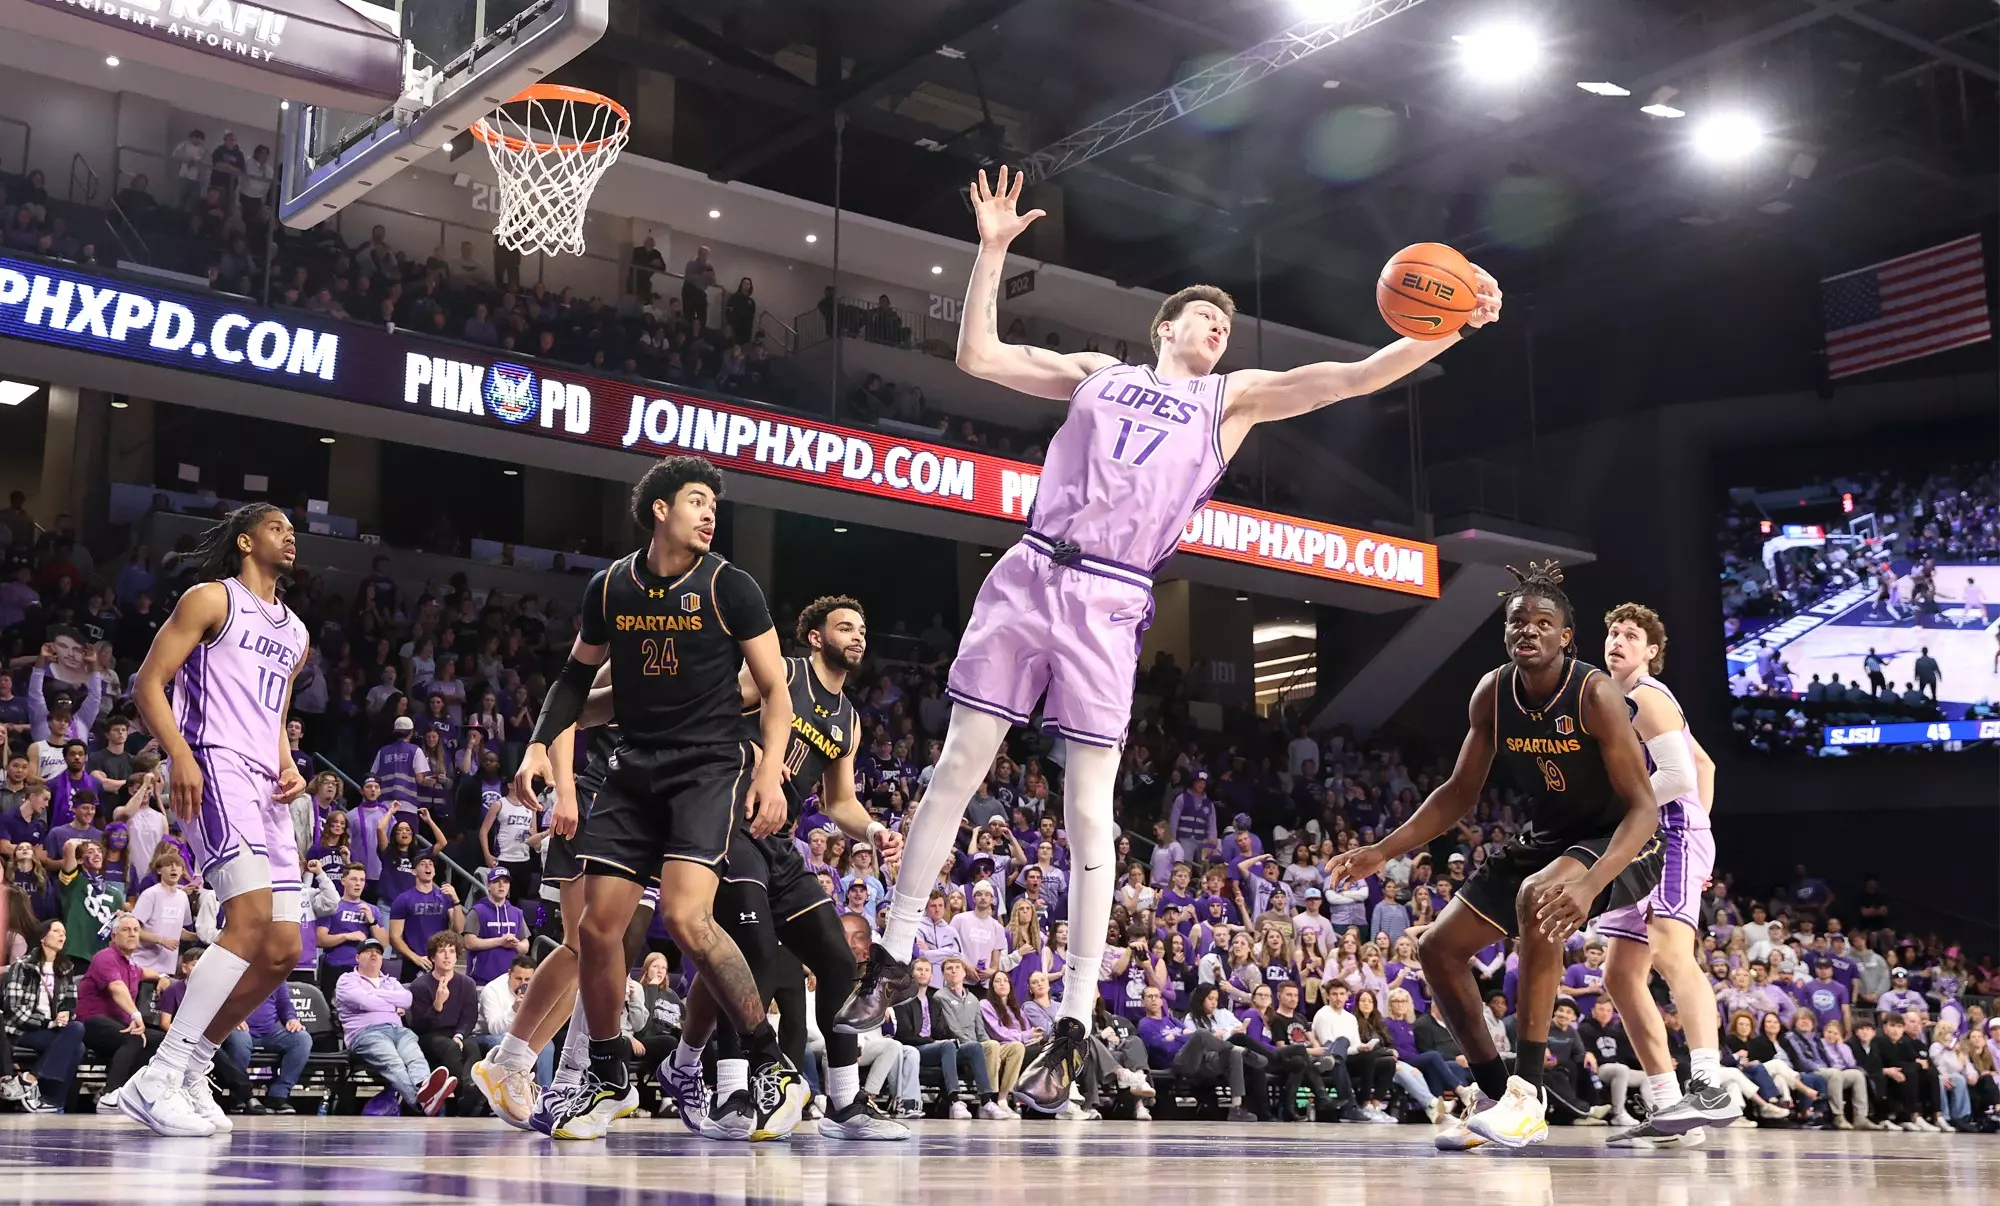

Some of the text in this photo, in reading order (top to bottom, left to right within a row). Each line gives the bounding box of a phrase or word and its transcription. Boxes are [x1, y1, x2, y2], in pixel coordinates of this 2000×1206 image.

[167, 22, 275, 62] ATTORNEY
[1009, 276, 1030, 294] 202
[1401, 272, 1455, 301] ELITE
[0, 267, 341, 381] PHXPD.COM
[403, 352, 592, 434] PHX PD
[1096, 380, 1199, 425] LOPES
[622, 394, 976, 502] JOINPHXPD.COM
[1111, 416, 1170, 467] 17
[615, 614, 703, 631] SPARTANS
[238, 629, 299, 673] LOPES
[641, 637, 679, 676] 24
[257, 664, 287, 714] 10
[1506, 737, 1582, 755] SPARTANS
[1830, 727, 1881, 745] SJSU
[1926, 723, 1951, 741] 45
[784, 737, 811, 776] 11
[415, 902, 443, 915] GCU
